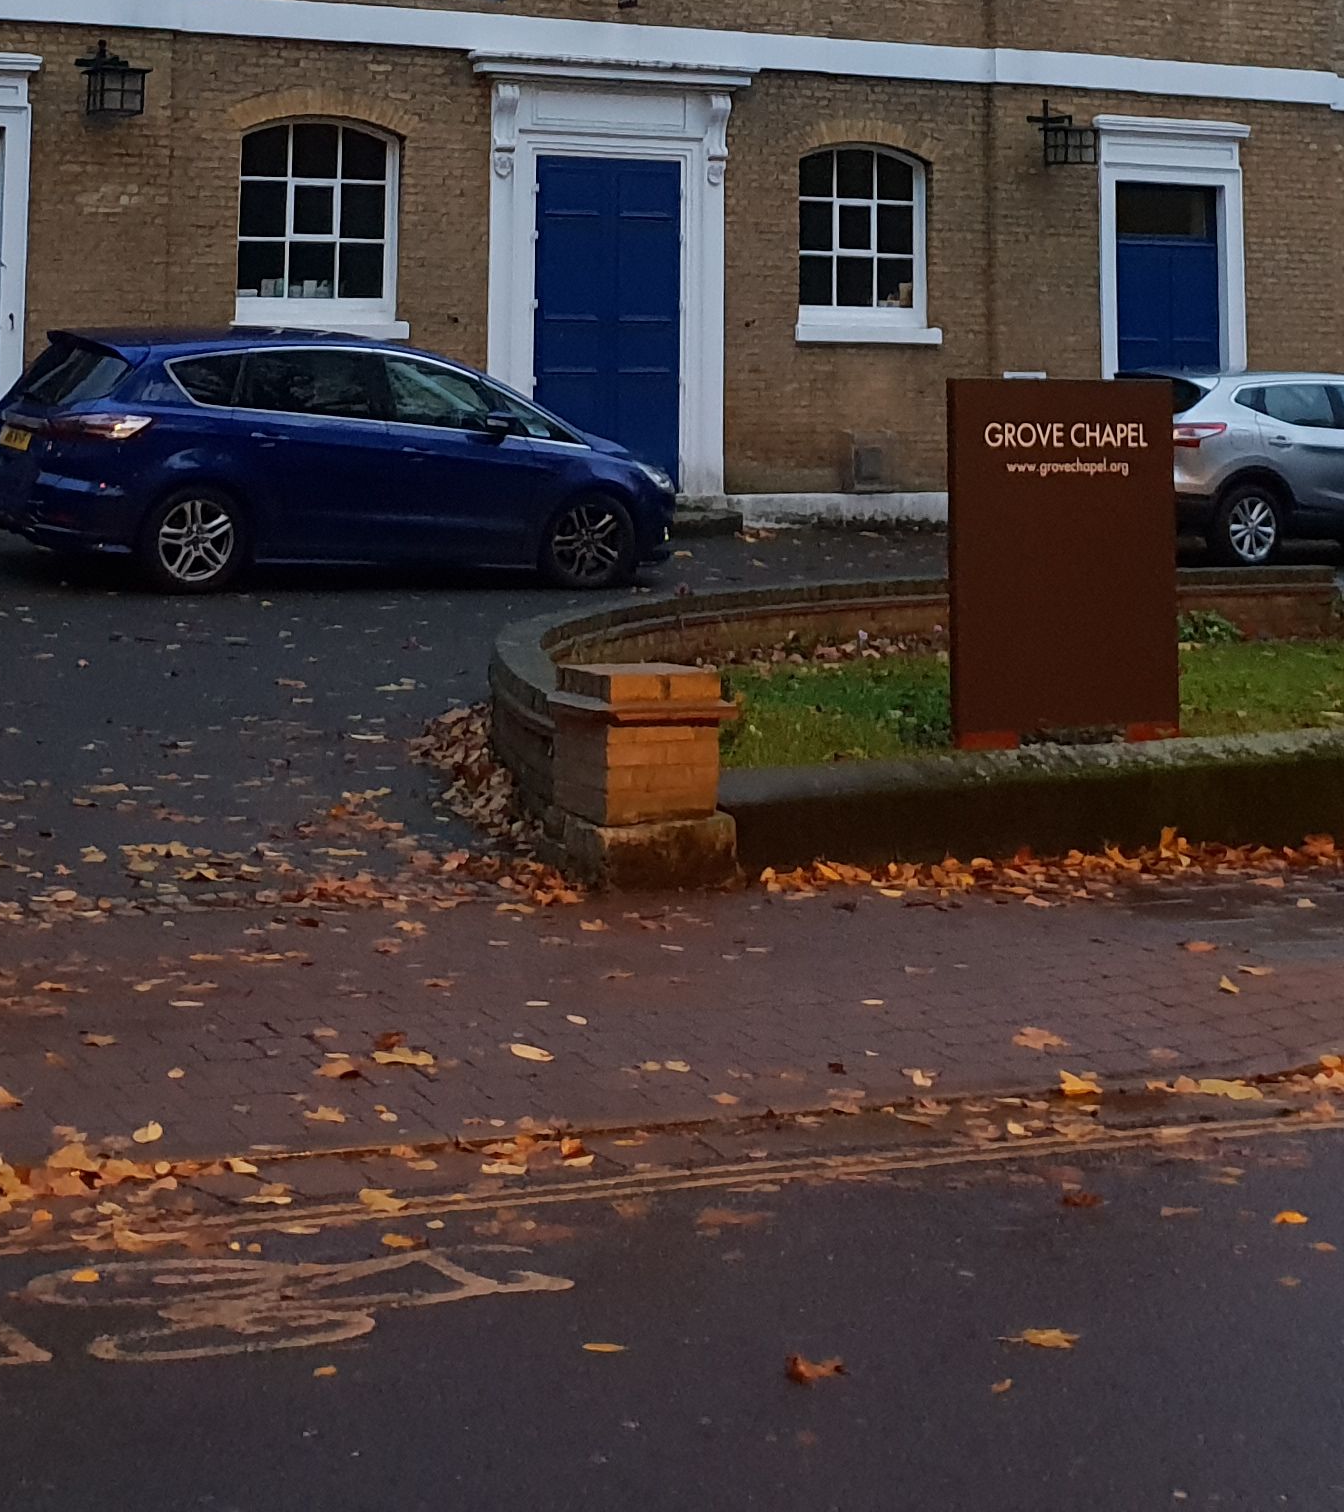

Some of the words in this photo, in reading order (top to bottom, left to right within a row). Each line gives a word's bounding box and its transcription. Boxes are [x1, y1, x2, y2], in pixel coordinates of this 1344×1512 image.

[984, 422, 1065, 448] GROVE
[1070, 422, 1149, 448] CHAPEL
[1006, 457, 1130, 477] www.grovechapel.org
